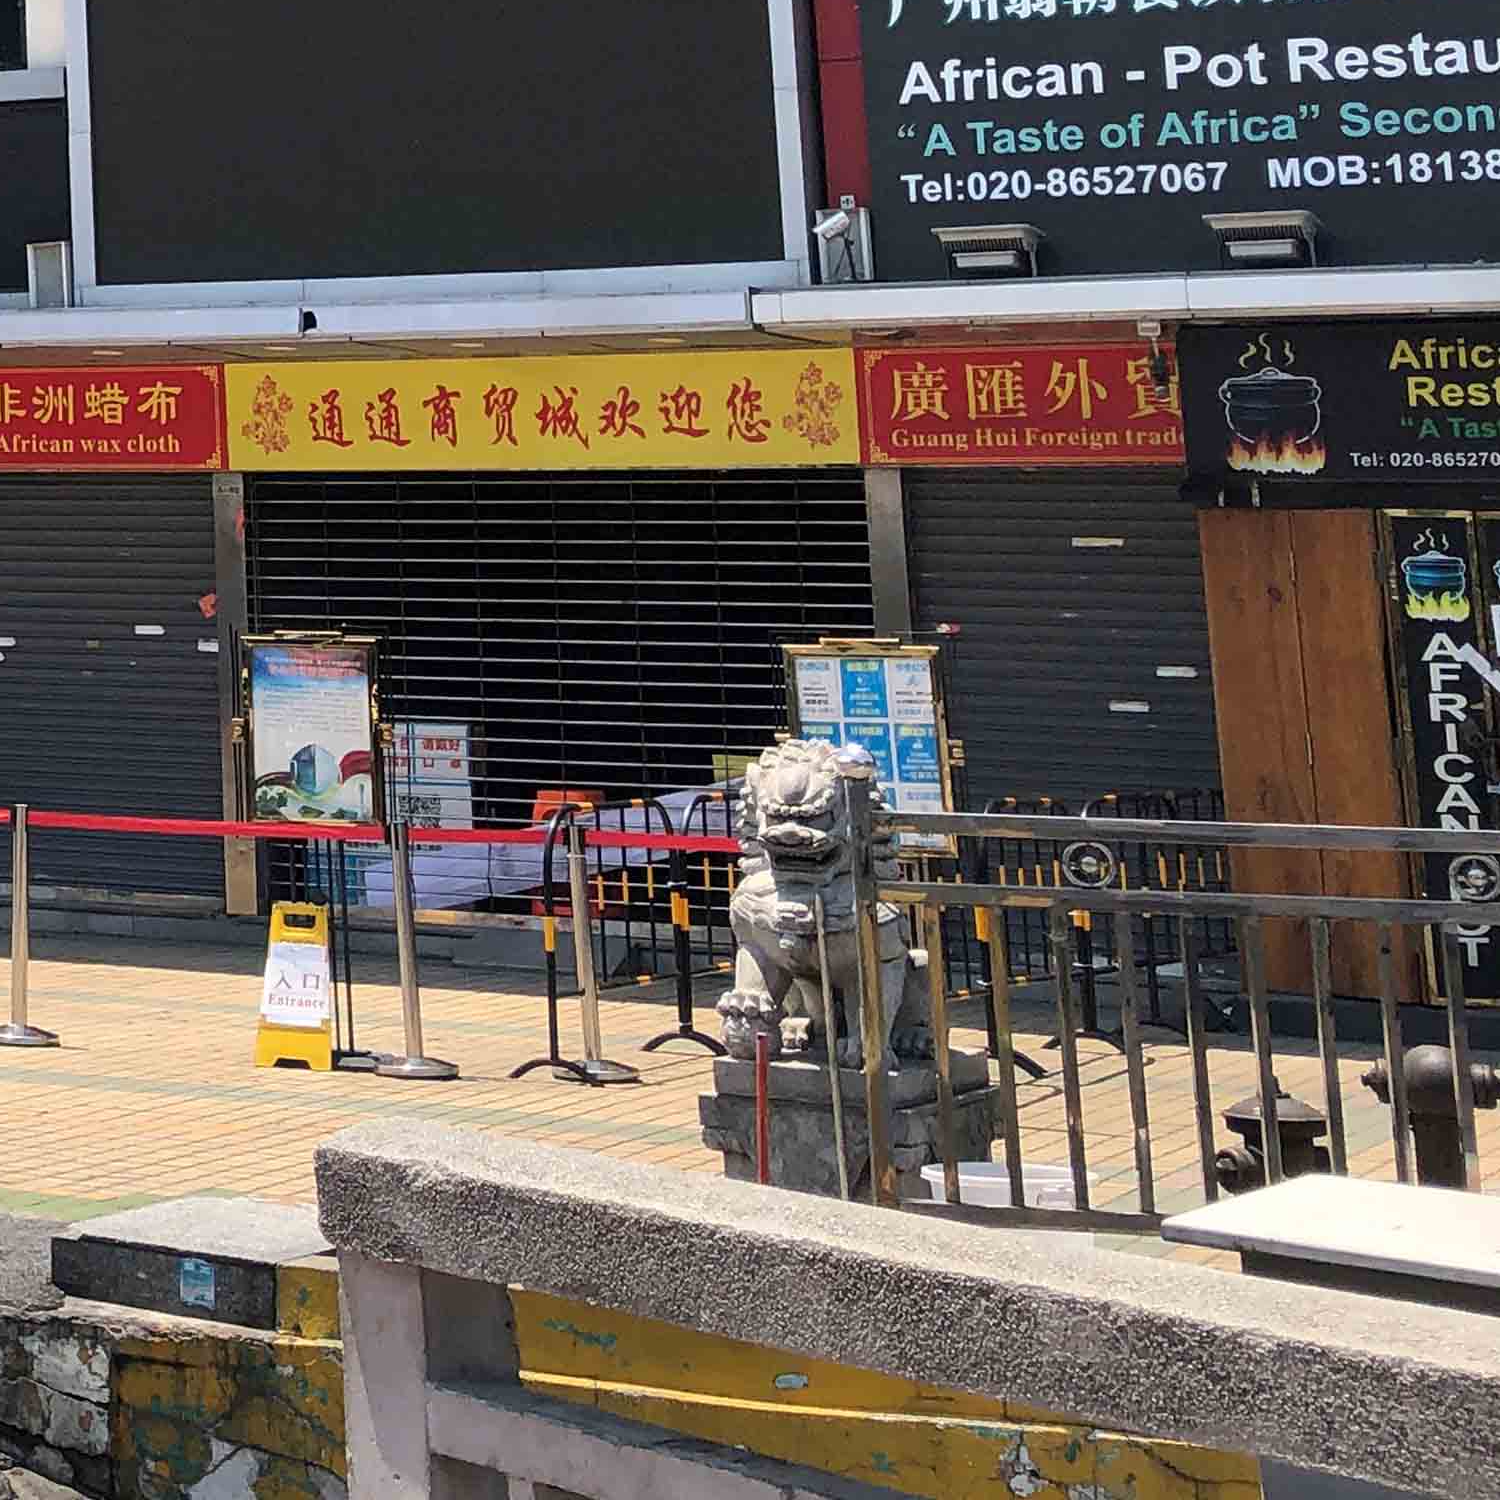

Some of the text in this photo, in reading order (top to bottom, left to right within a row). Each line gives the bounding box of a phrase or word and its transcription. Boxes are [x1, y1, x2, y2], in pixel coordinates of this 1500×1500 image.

[899, 57, 1104, 105] African
[1163, 42, 1269, 90] Pot
[966, 119, 1084, 155] Taste
[1100, 114, 1145, 149] of
[1339, 102, 1500, 138] Secon
[901, 161, 1229, 203] Tel:020-86527067
[1388, 337, 1500, 371] Afric
[308, 376, 772, 450] 通通商贸城欢迎您
[891, 426, 1184, 451] Guang Hui Foreign trad
[1447, 416, 1500, 439] Tas
[80, 437, 121, 453] wax
[127, 433, 181, 453] cloth
[1349, 452, 1385, 468] Tel:
[273, 970, 321, 990] 入口
[267, 992, 326, 1009] Entrance
